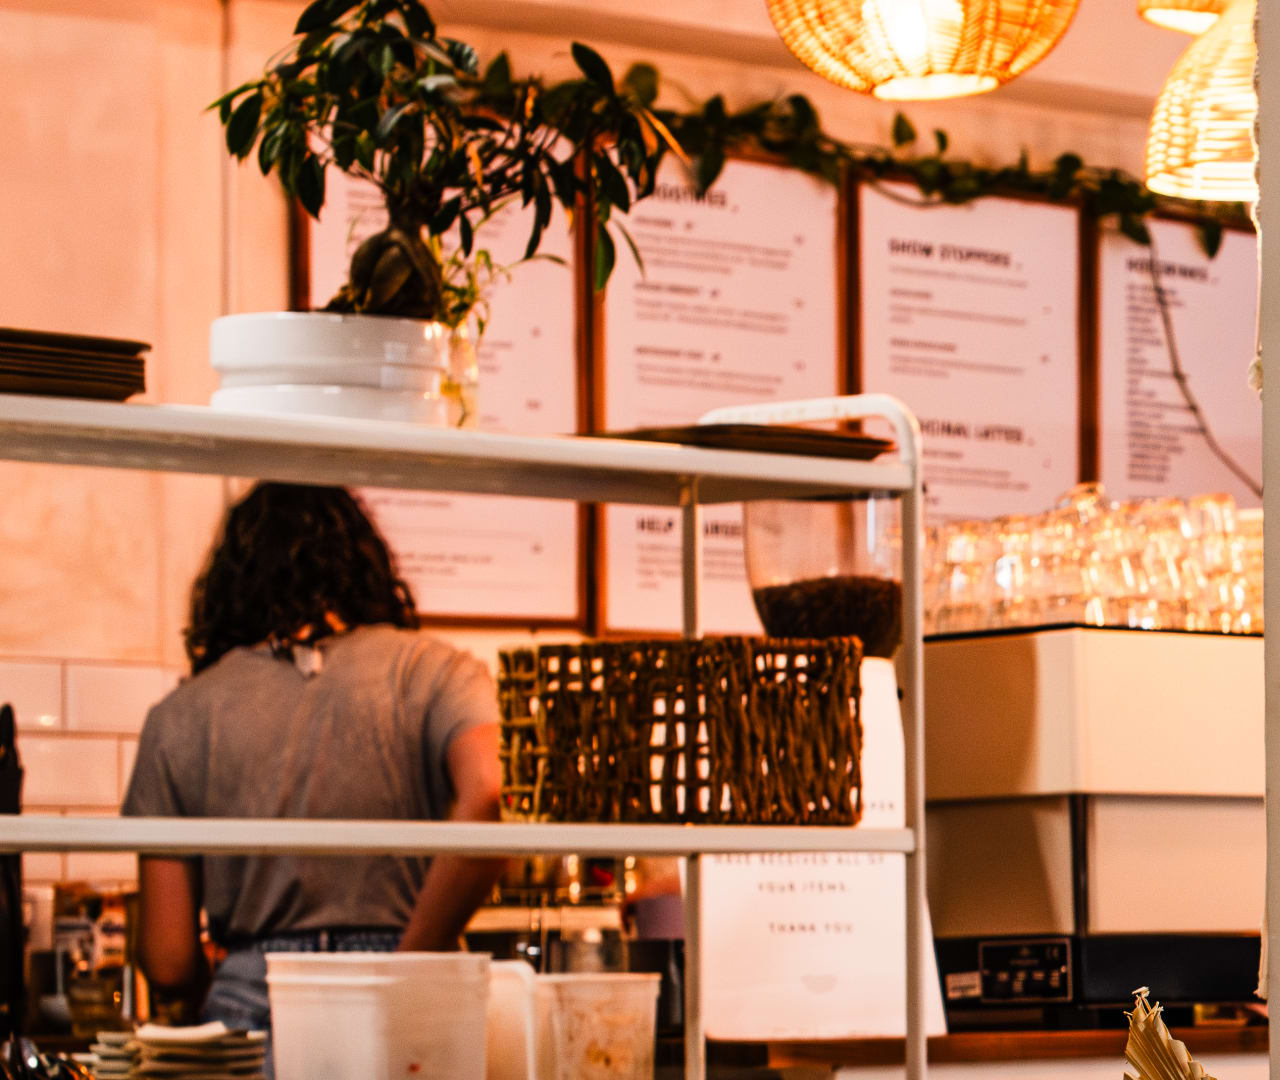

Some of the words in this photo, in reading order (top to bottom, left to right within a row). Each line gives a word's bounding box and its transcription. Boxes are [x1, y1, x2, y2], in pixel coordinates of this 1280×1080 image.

[940, 244, 1010, 267] STOPPERS
[759, 855, 828, 864] RECEIVED
[758, 882, 796, 892] YOUR
[768, 922, 817, 933] THANK
[824, 922, 854, 933] YOU
